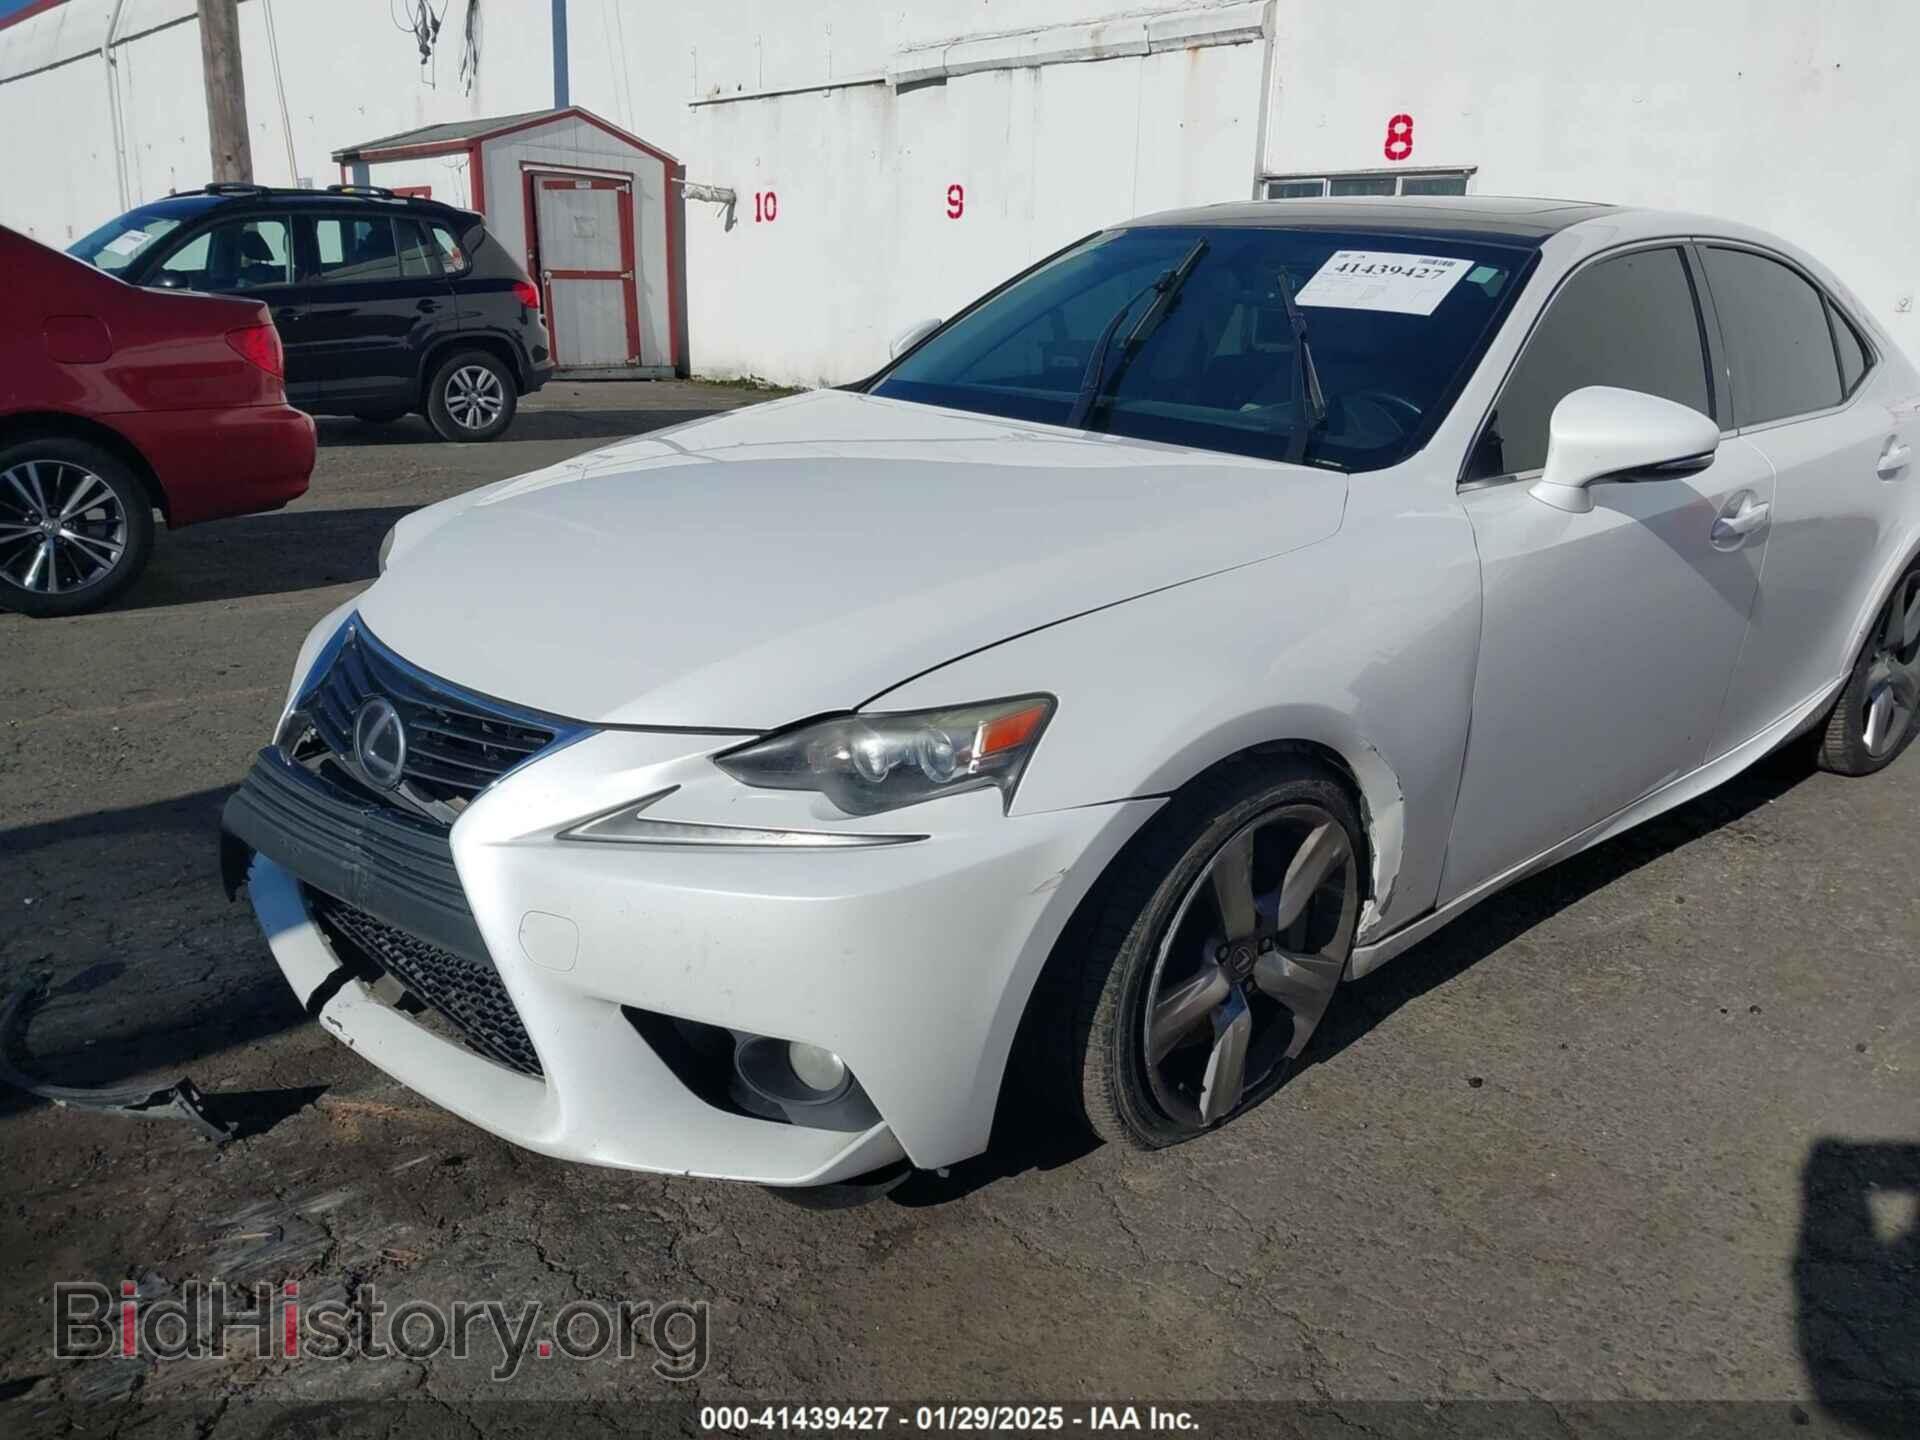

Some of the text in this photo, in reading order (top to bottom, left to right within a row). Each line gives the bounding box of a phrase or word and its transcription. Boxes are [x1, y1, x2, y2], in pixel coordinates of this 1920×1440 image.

[1384, 114, 1414, 161] 8
[754, 191, 778, 223] 10
[946, 184, 965, 220] 9
[1335, 262, 1447, 281] 41439427
